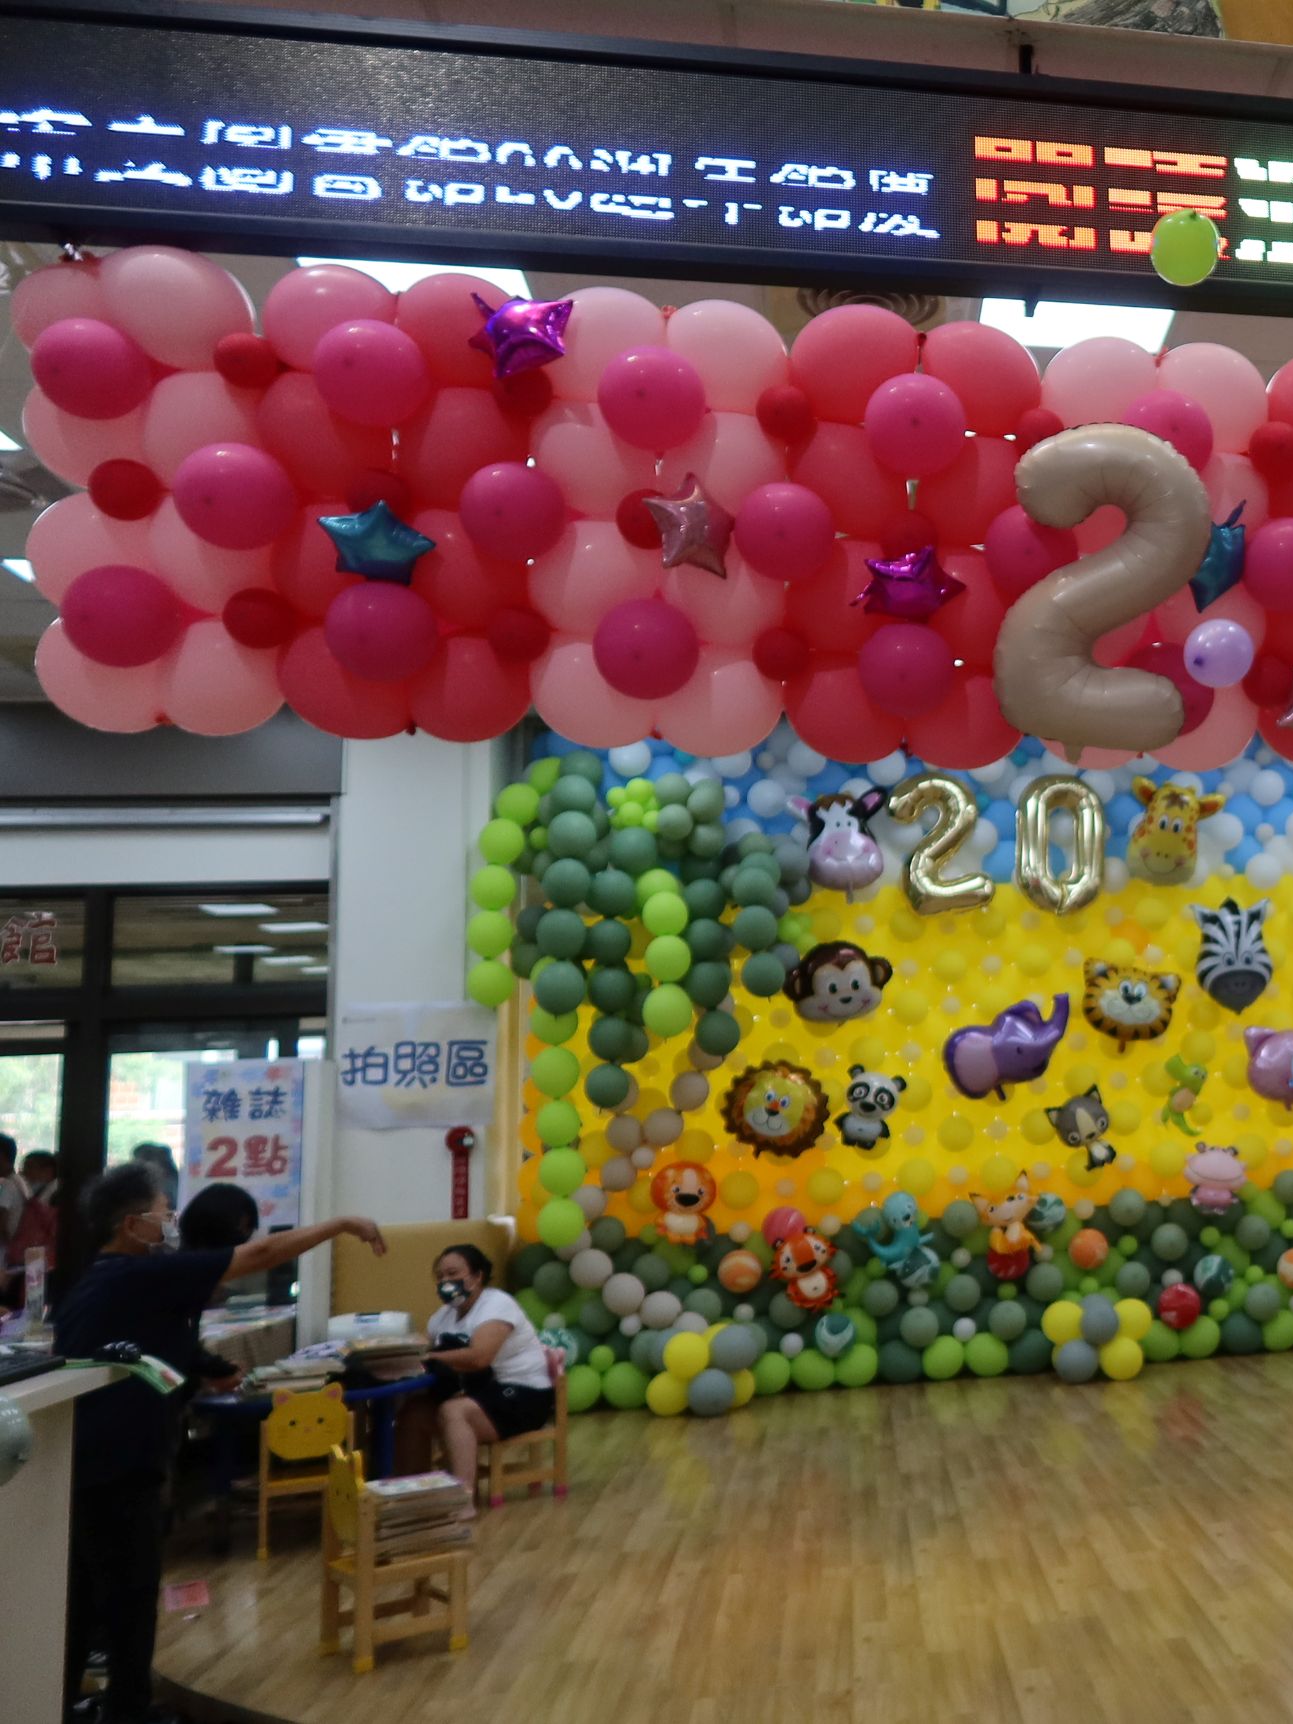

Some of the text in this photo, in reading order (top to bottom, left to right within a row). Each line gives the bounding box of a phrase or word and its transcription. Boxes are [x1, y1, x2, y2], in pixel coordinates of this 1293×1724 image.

[0, 912, 57, 965] 館
[340, 1040, 488, 1089] 拍照區
[202, 1086, 288, 1123] 雜誌
[206, 1133, 289, 1178] 2點
